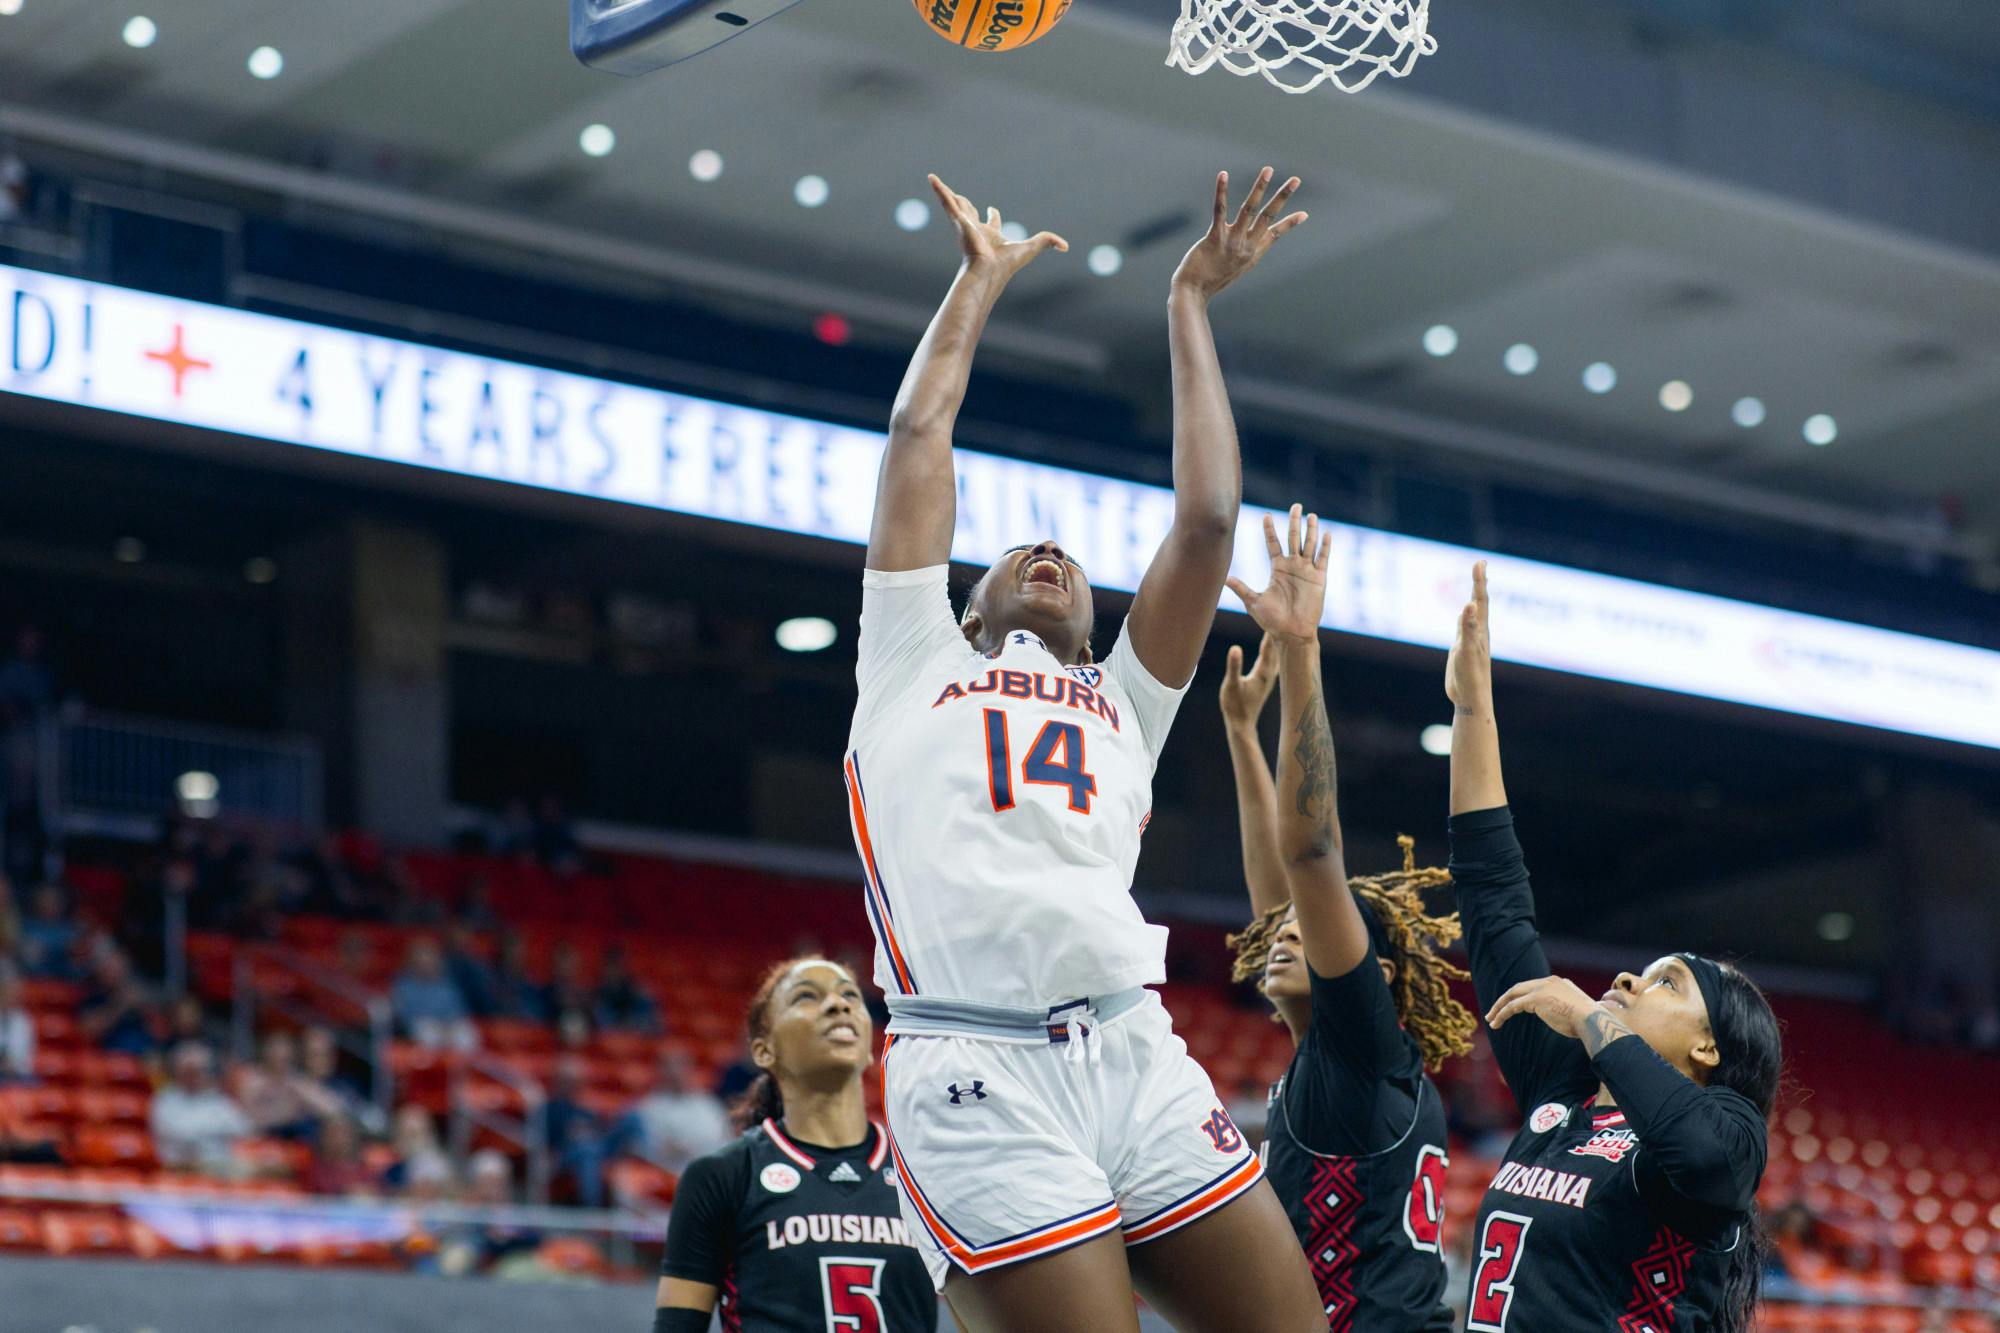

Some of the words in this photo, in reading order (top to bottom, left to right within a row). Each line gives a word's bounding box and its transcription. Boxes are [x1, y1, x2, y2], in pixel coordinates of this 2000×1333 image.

[277, 342, 314, 422] 4
[357, 351, 618, 484] YEARS
[661, 408, 834, 520] FREE
[931, 668, 1120, 733] AUBURN
[982, 707, 1098, 815] 14
[766, 1213, 918, 1250] LOUISIAN
[1467, 1210, 1533, 1333] 2
[819, 1256, 888, 1333] 5
